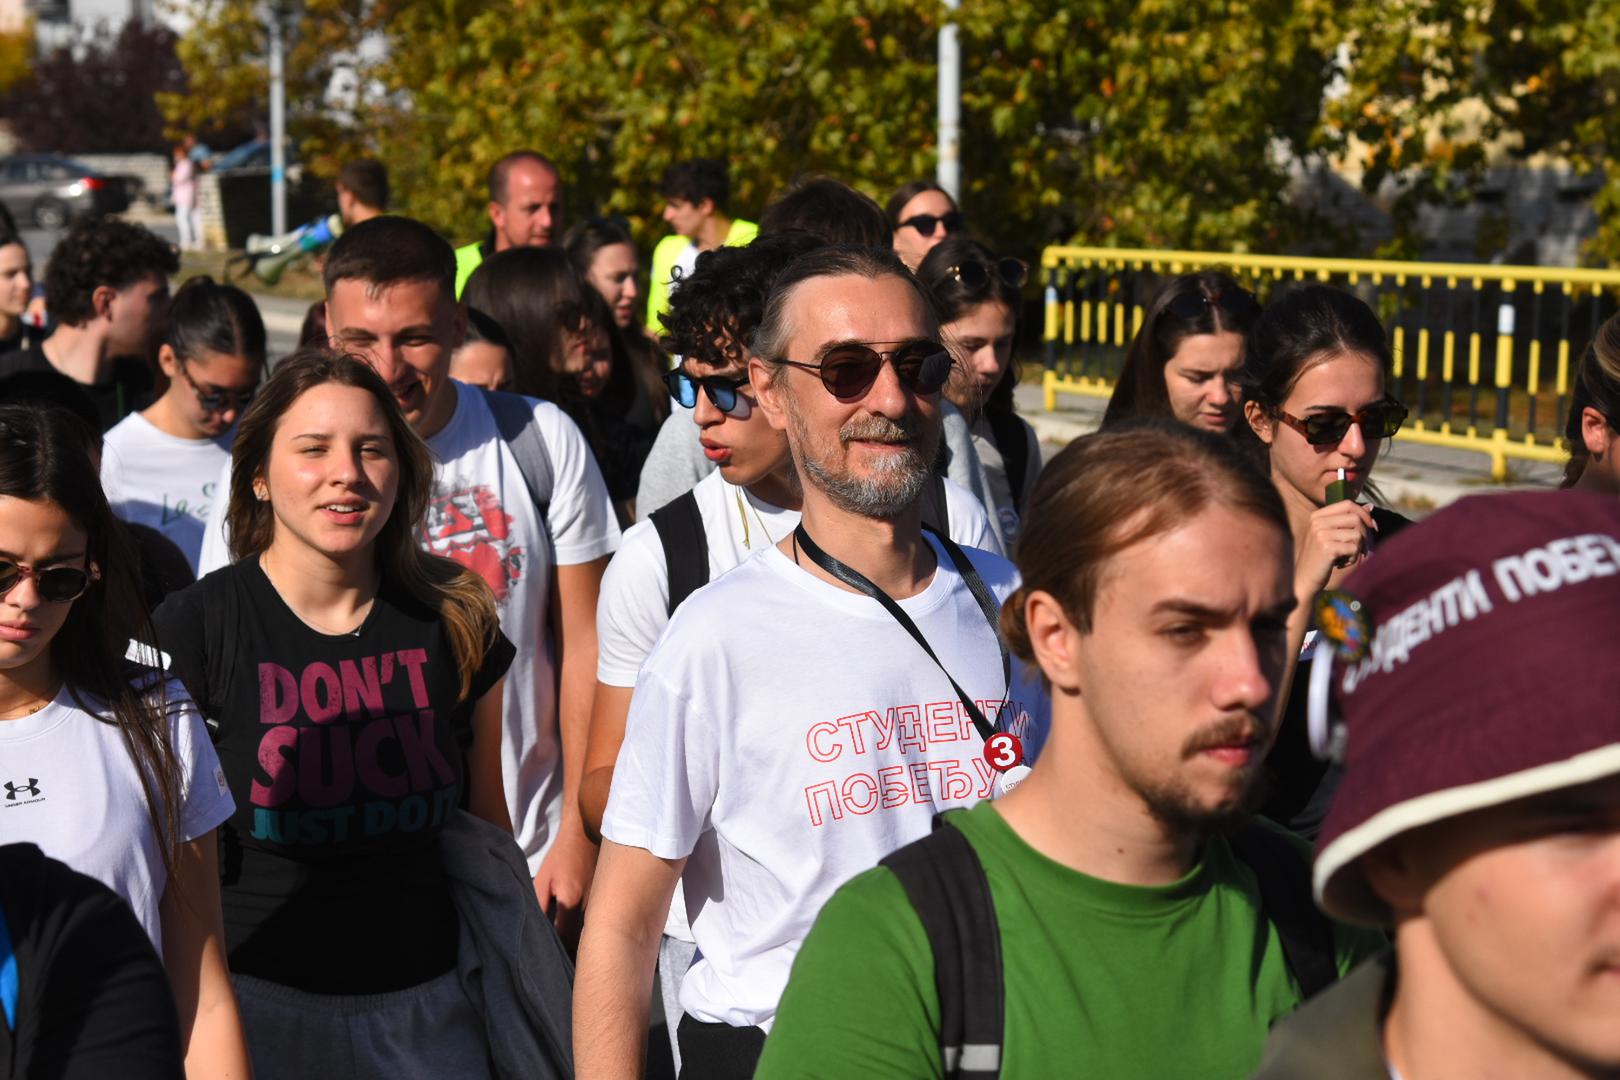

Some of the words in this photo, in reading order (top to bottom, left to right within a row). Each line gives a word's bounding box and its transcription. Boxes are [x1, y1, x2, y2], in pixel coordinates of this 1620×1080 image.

[1491, 533, 1620, 603] ПОБЕ
[258, 648, 430, 724] DON'T
[250, 709, 457, 808] SUCK
[806, 700, 1030, 763] СТУДЕНТИ
[991, 736, 1016, 767] 3
[249, 806, 355, 845] JUST
[363, 795, 429, 835] DO
[804, 757, 998, 827] ПОБЕЂУ
